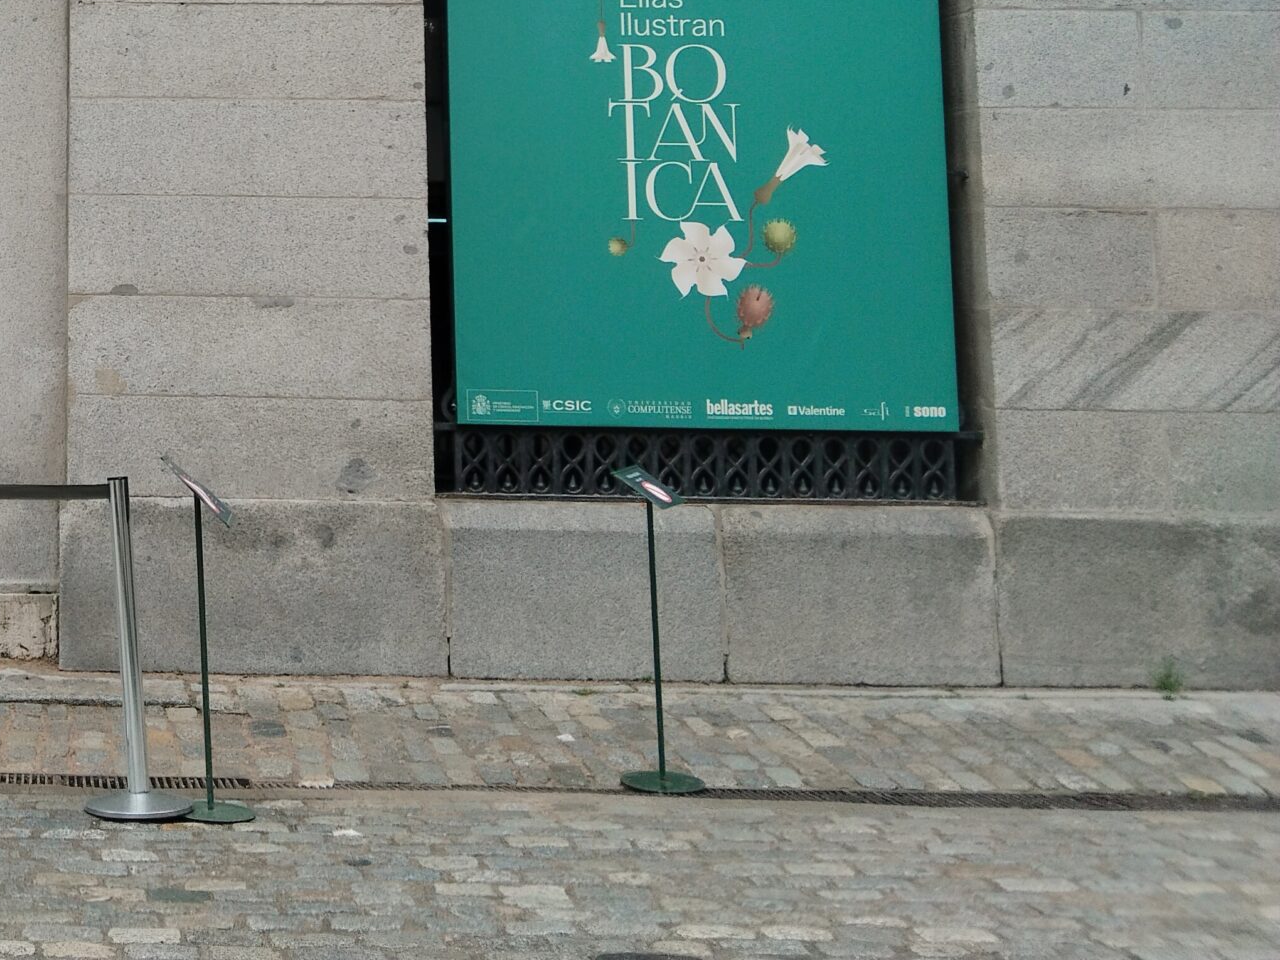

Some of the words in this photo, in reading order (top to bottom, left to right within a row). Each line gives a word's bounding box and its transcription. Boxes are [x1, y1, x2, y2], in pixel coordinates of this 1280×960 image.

[620, 12, 726, 37] Ilustran
[552, 400, 592, 411] CSIC
[628, 405, 693, 415] COMPLUTENSE
[706, 398, 774, 417] bellasartes
[798, 405, 846, 416] Valentine
[913, 405, 947, 418] sono
